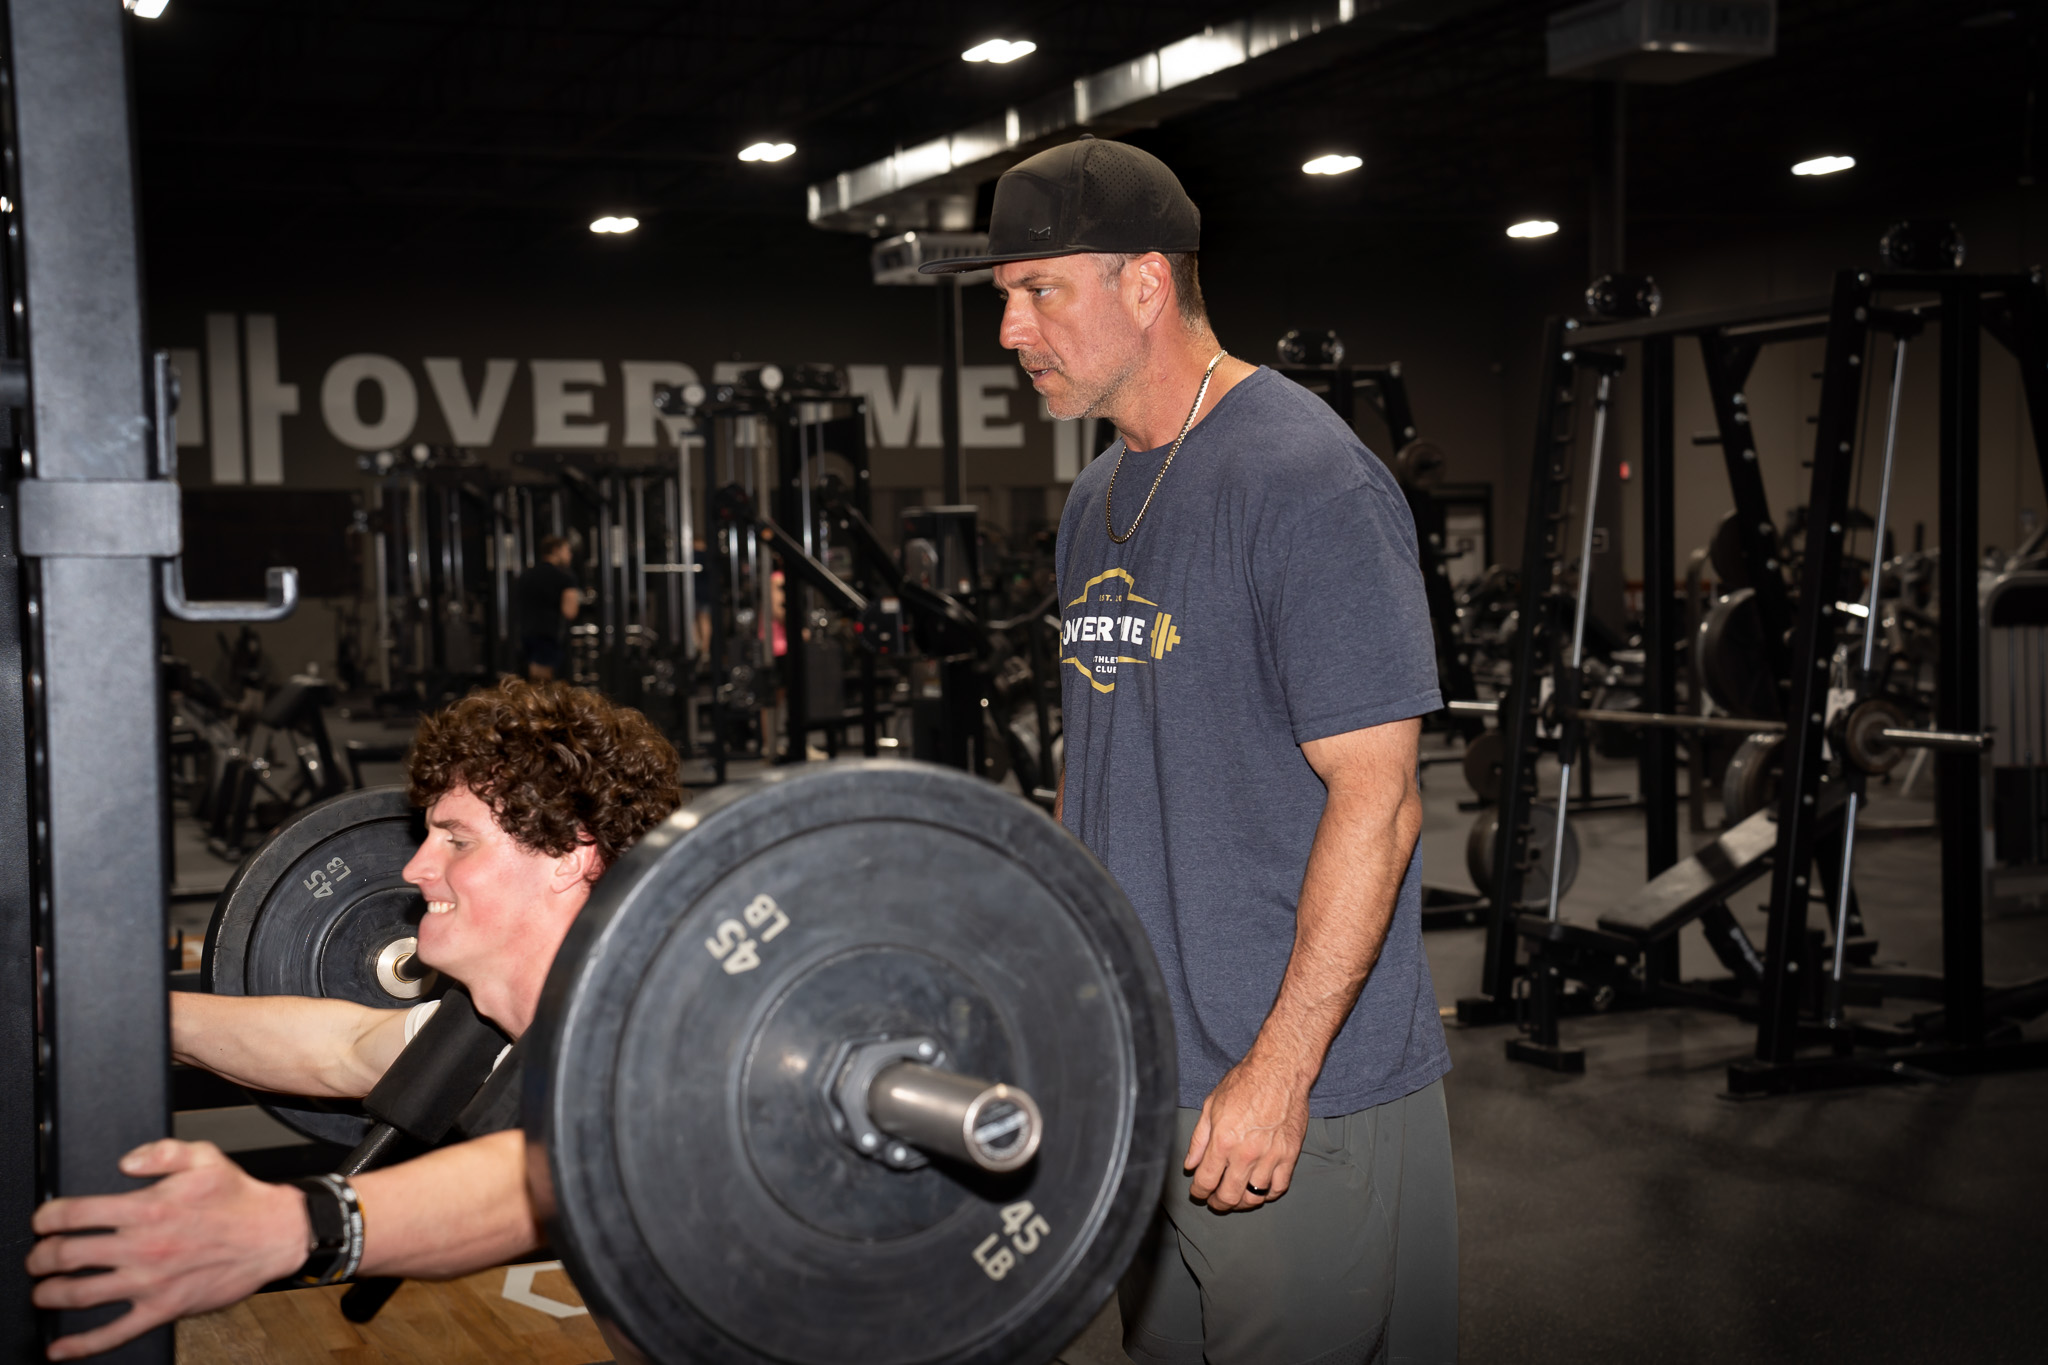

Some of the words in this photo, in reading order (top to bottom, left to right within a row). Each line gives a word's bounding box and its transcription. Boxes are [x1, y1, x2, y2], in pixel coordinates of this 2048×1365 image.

[320, 353, 1025, 450] OVERME
[303, 869, 334, 899] 45
[326, 856, 352, 882] LB
[743, 893, 791, 943] LB
[704, 918, 762, 976] 45
[1000, 1200, 1051, 1255] 45
[971, 1232, 1016, 1282] LB
